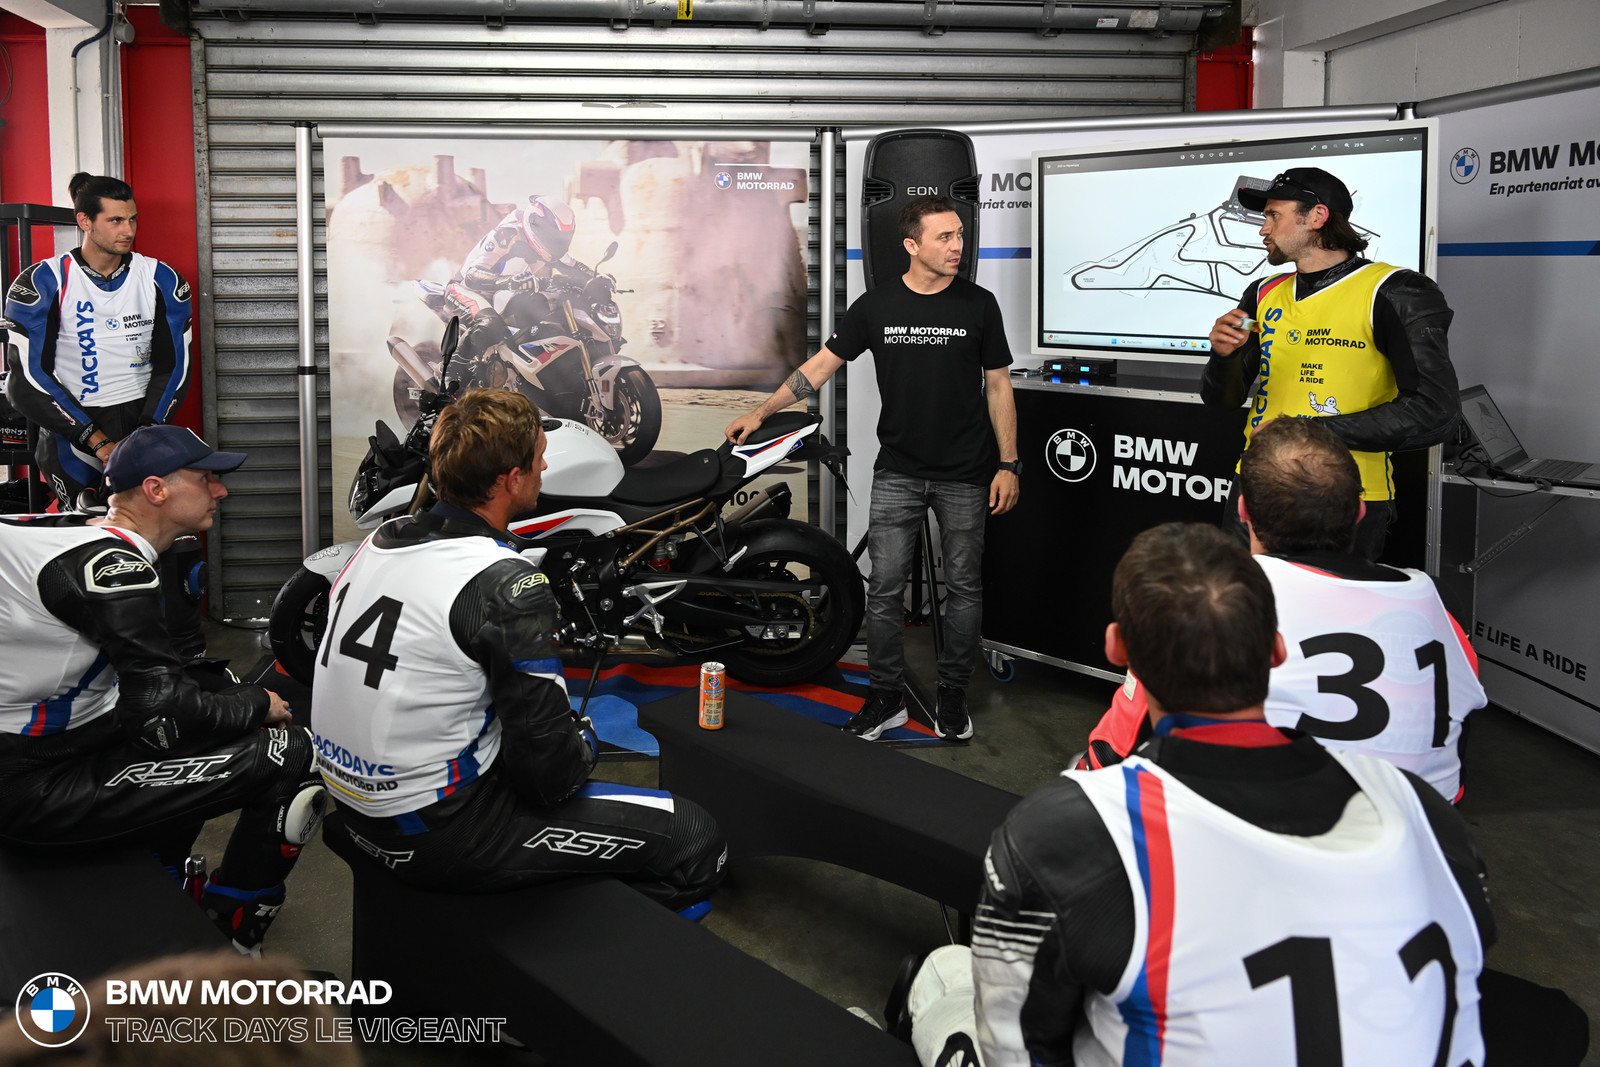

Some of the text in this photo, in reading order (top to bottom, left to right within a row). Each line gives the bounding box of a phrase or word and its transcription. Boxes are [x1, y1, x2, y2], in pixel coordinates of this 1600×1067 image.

[1490, 140, 1600, 174] BMW M
[737, 172, 763, 181] BMW
[736, 181, 795, 191] MOTORRAD
[906, 186, 939, 196] EON
[1489, 183, 1505, 195] En
[1506, 176, 1583, 198] partenariat
[1006, 200, 1032, 210] ave
[11, 283, 39, 296] ST
[122, 313, 142, 323] BMW
[884, 326, 967, 337] BMW MOTORRAD
[1306, 328, 1332, 337] BMW
[884, 335, 950, 345] MOTORSPORT
[1304, 337, 1367, 350] MOTORRAD
[1301, 362, 1324, 371] MAKE
[1299, 376, 1325, 385] A RIDE
[1114, 434, 1199, 467] BMW
[320, 581, 404, 691] 14
[1486, 626, 1521, 654] LIFE
[1525, 643, 1539, 661] A
[1543, 648, 1587, 682] RIDE
[1295, 632, 1452, 749] 31
[104, 754, 233, 787] RST
[334, 767, 399, 793] MOTORRAD
[522, 826, 646, 860] RST
